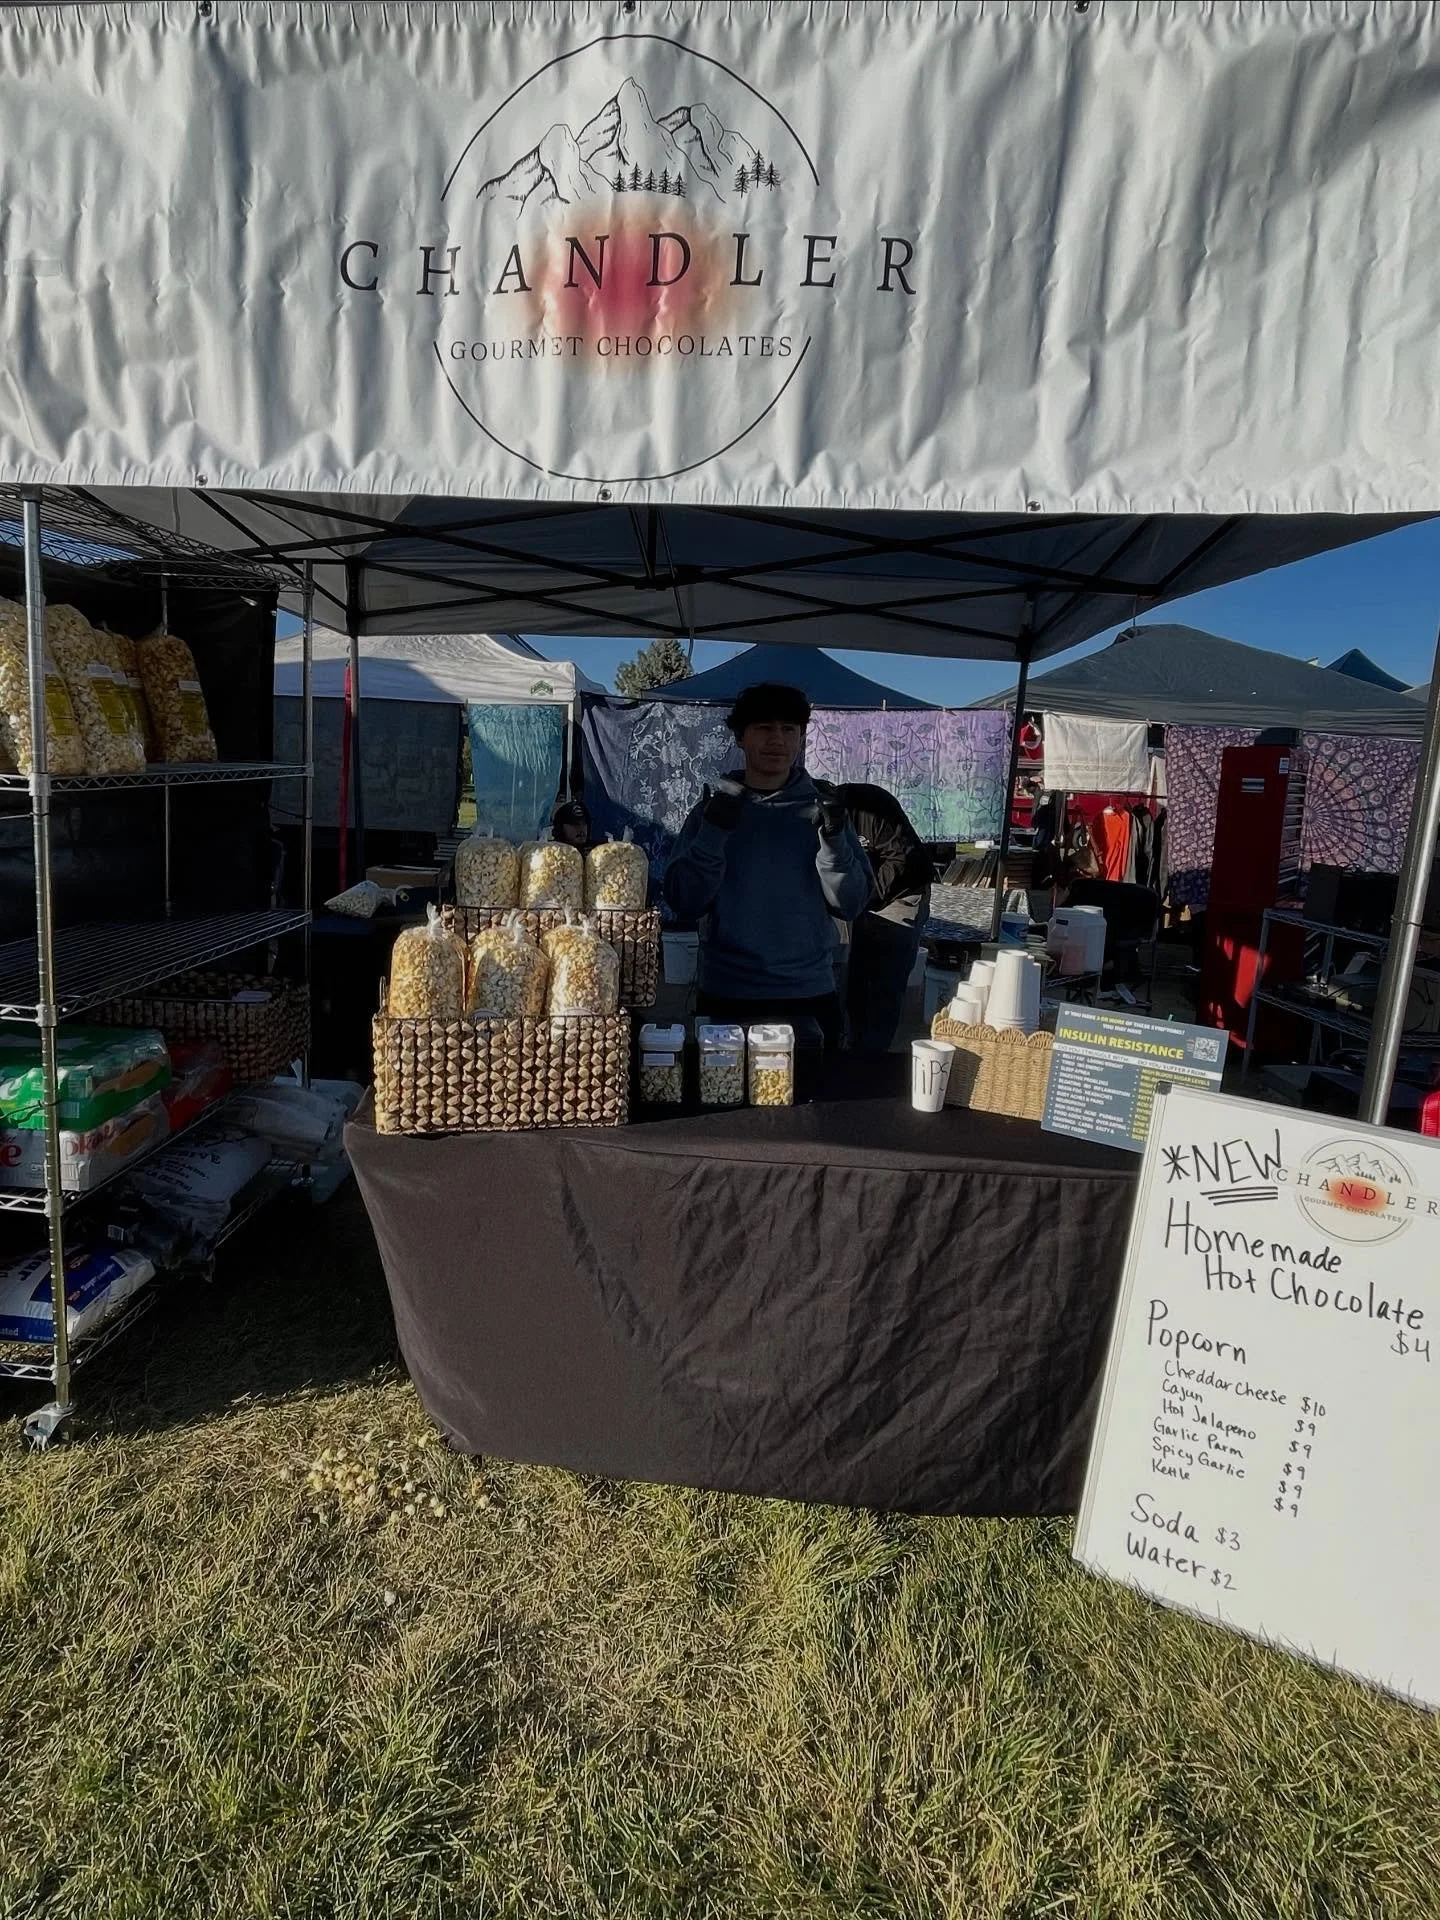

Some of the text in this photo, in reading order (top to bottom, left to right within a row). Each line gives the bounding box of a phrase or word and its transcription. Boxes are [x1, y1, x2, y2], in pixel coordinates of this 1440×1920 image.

[340, 232, 916, 297] CHANDLER
[450, 335, 793, 361] GOURMET CHOCOLATES
[1058, 1027, 1107, 1046] INSULIN
[1108, 1036, 1184, 1060] RESISTANCE
[1276, 1169, 1439, 1215] CHANDLER
[1304, 1195, 1402, 1223] GOURMET CHOCOLATES
[1165, 1198, 1342, 1273] Homemade
[1205, 1254, 1425, 1330] Hot Chocolate
[1148, 1300, 1247, 1365] Popcorn
[1391, 1331, 1431, 1363] $4
[1162, 1379, 1203, 1403] Cajun
[1165, 1360, 1232, 1391] Cheddar
[1301, 1396, 1326, 1417] $10
[1154, 1416, 1199, 1443] Garlic
[1208, 1434, 1245, 1459] Parm
[1163, 1399, 1185, 1417] Hot
[1193, 1406, 1257, 1440] Jalapeno
[1152, 1459, 1190, 1480] Kettle
[1153, 1436, 1194, 1466] Spicy
[1198, 1453, 1246, 1479] Garlic
[1131, 1493, 1241, 1551] Soda $3
[1127, 1531, 1238, 1591] Water $2
